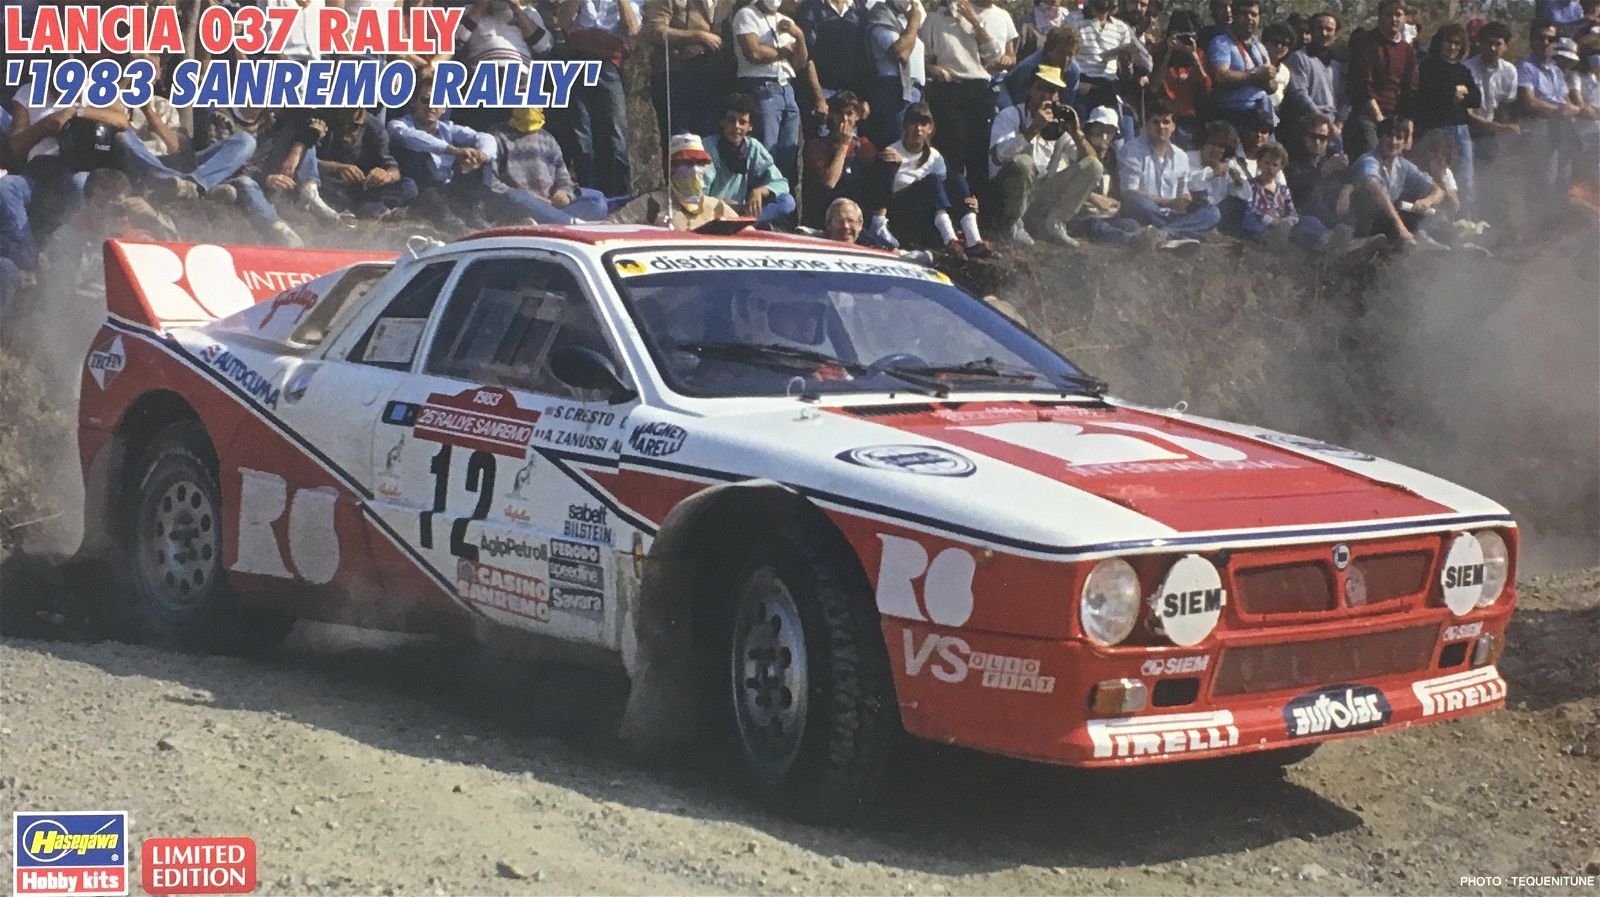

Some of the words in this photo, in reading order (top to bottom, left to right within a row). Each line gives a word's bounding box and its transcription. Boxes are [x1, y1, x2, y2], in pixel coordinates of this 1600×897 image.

[650, 255, 830, 272] distribuzione
[473, 419, 531, 442] SANREMO
[420, 441, 497, 561] 12
[564, 520, 612, 543] BILSTEIN
[478, 567, 549, 601] CASINO
[552, 588, 603, 610] Savara
[1163, 588, 1223, 618] SIEM
[903, 628, 971, 683] VS
[1411, 665, 1507, 717] PIRELLI
[1086, 709, 1239, 758] PIRELLI
